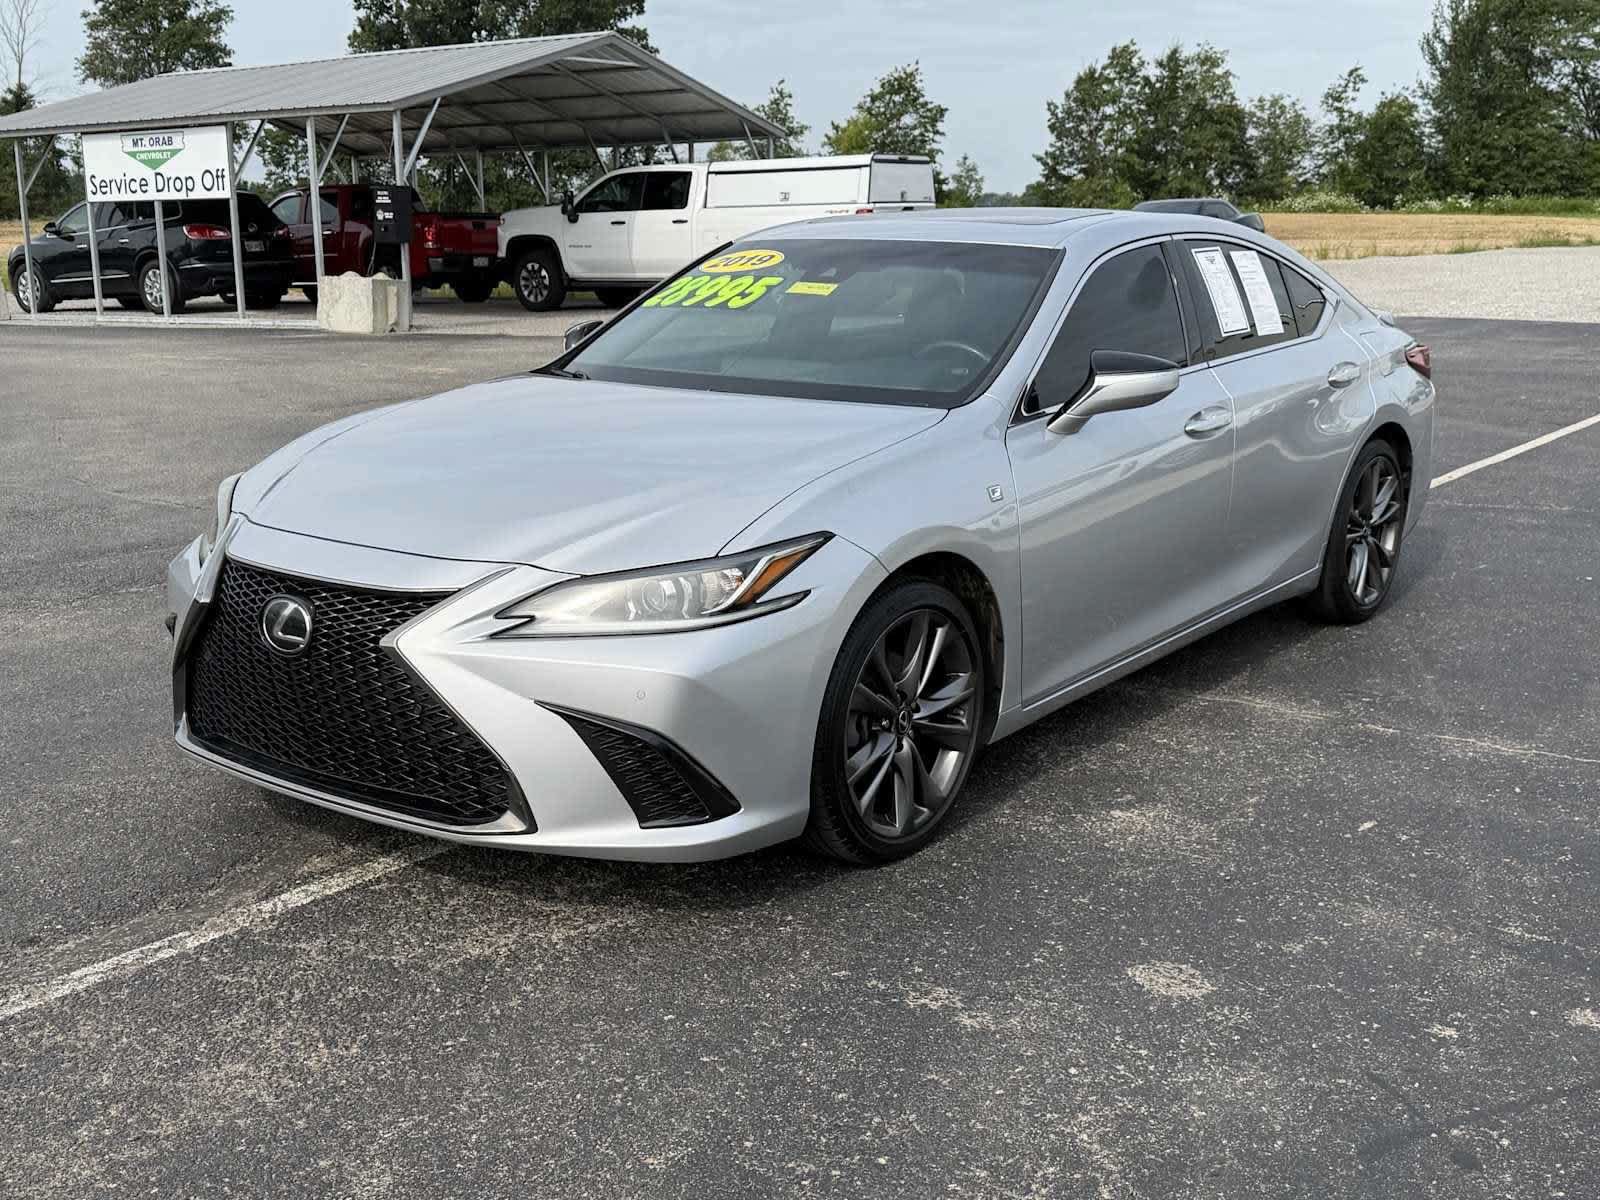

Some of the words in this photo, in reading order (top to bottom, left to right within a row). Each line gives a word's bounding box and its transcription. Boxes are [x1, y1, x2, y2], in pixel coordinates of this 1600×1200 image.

[131, 138, 146, 148] MT.
[148, 136, 174, 147] ORAB
[136, 151, 171, 160] CHEVROLET
[89, 172, 149, 196] Service
[154, 172, 195, 198] Drop
[201, 168, 226, 192] Off
[706, 254, 776, 269] 2019
